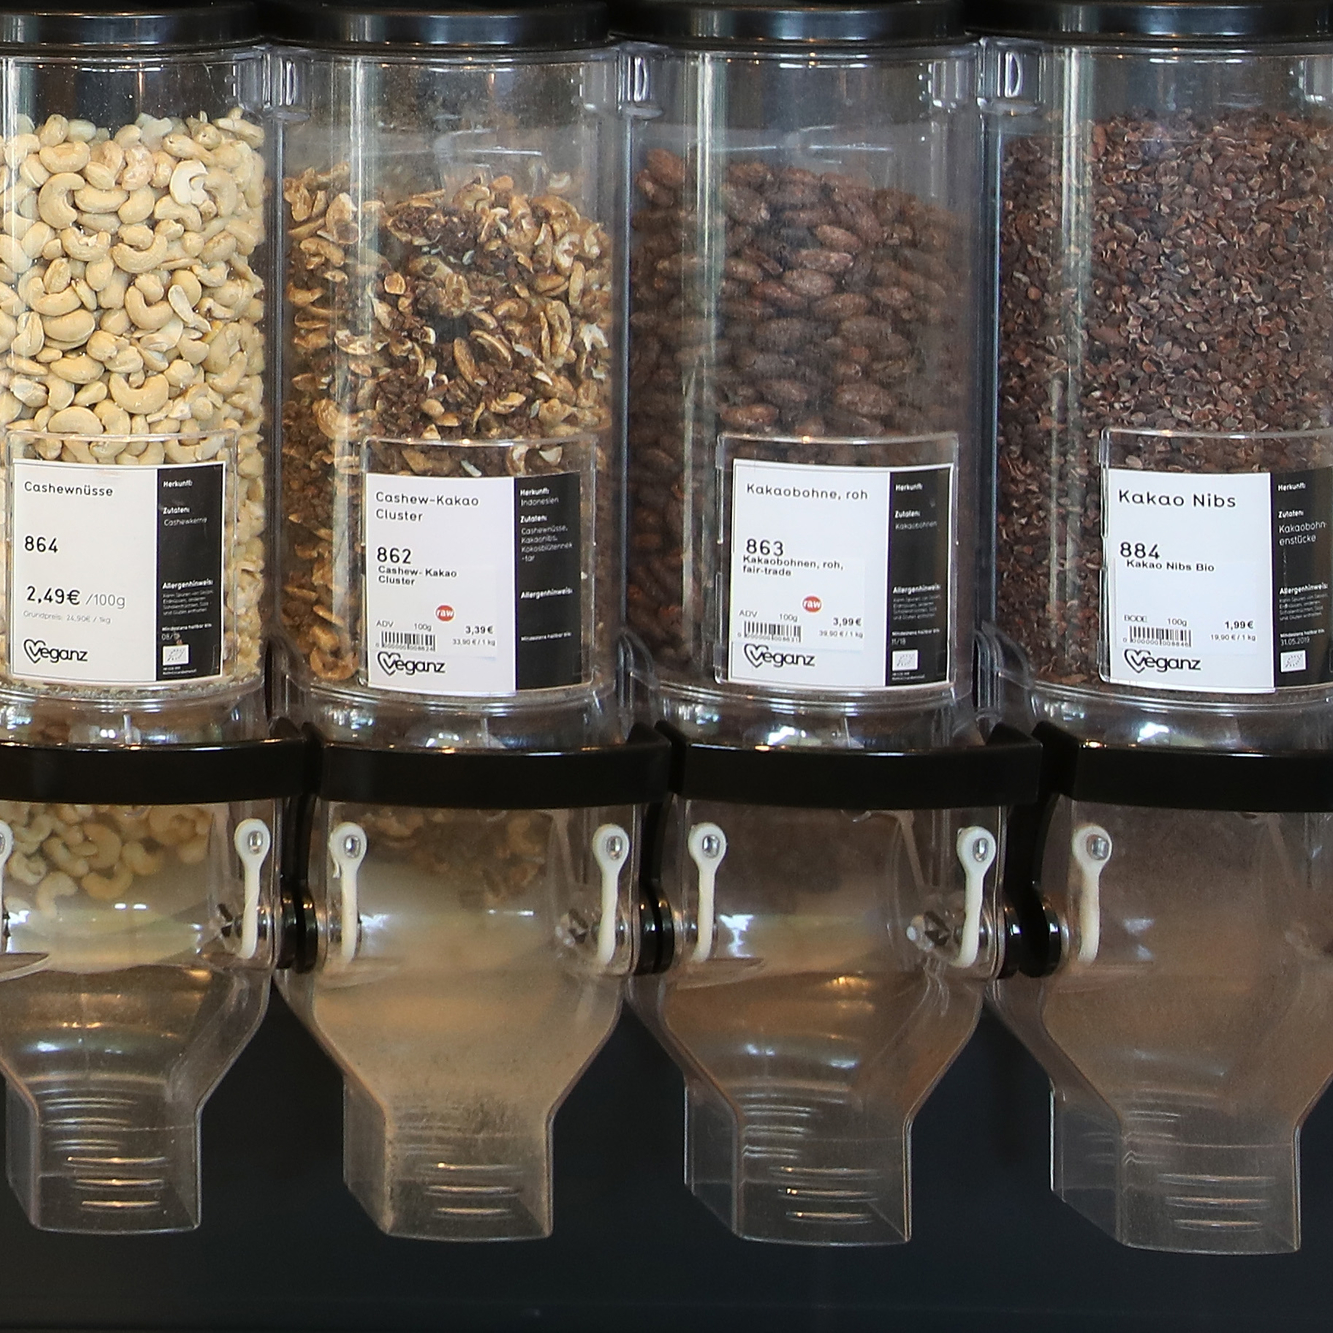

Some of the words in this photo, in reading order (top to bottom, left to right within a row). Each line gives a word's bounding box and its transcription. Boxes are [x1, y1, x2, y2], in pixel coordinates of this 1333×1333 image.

[24, 481, 114, 497] Cashewnüsse
[746, 483, 841, 500] Kakaobohne,
[846, 491, 868, 500] roh
[376, 492, 479, 506] Cashew-Kakao
[1118, 489, 1184, 507] Kakao
[1193, 493, 1237, 508] Nibs
[376, 509, 423, 522] Cluster
[24, 535, 59, 553] 864
[746, 539, 784, 557] 863
[1279, 534, 1316, 546] enstücke
[377, 547, 412, 564] 862
[1120, 542, 1160, 559] 884
[743, 555, 819, 569] Kakaobohnen,
[823, 561, 843, 570] roh,
[1126, 559, 1163, 570] Kakao
[1167, 562, 1192, 571] Nibs
[1196, 564, 1215, 572] Bio
[425, 568, 457, 577] Kakao
[743, 565, 791, 577] fair-trade
[378, 576, 416, 586] Cluster
[26, 585, 81, 606] 2,49€
[86, 593, 126, 609] /100g
[802, 598, 822, 610] raw
[436, 608, 455, 618] raw
[23, 639, 88, 664] Veganz
[743, 643, 815, 668] Veganz
[377, 651, 446, 676] Veganz
